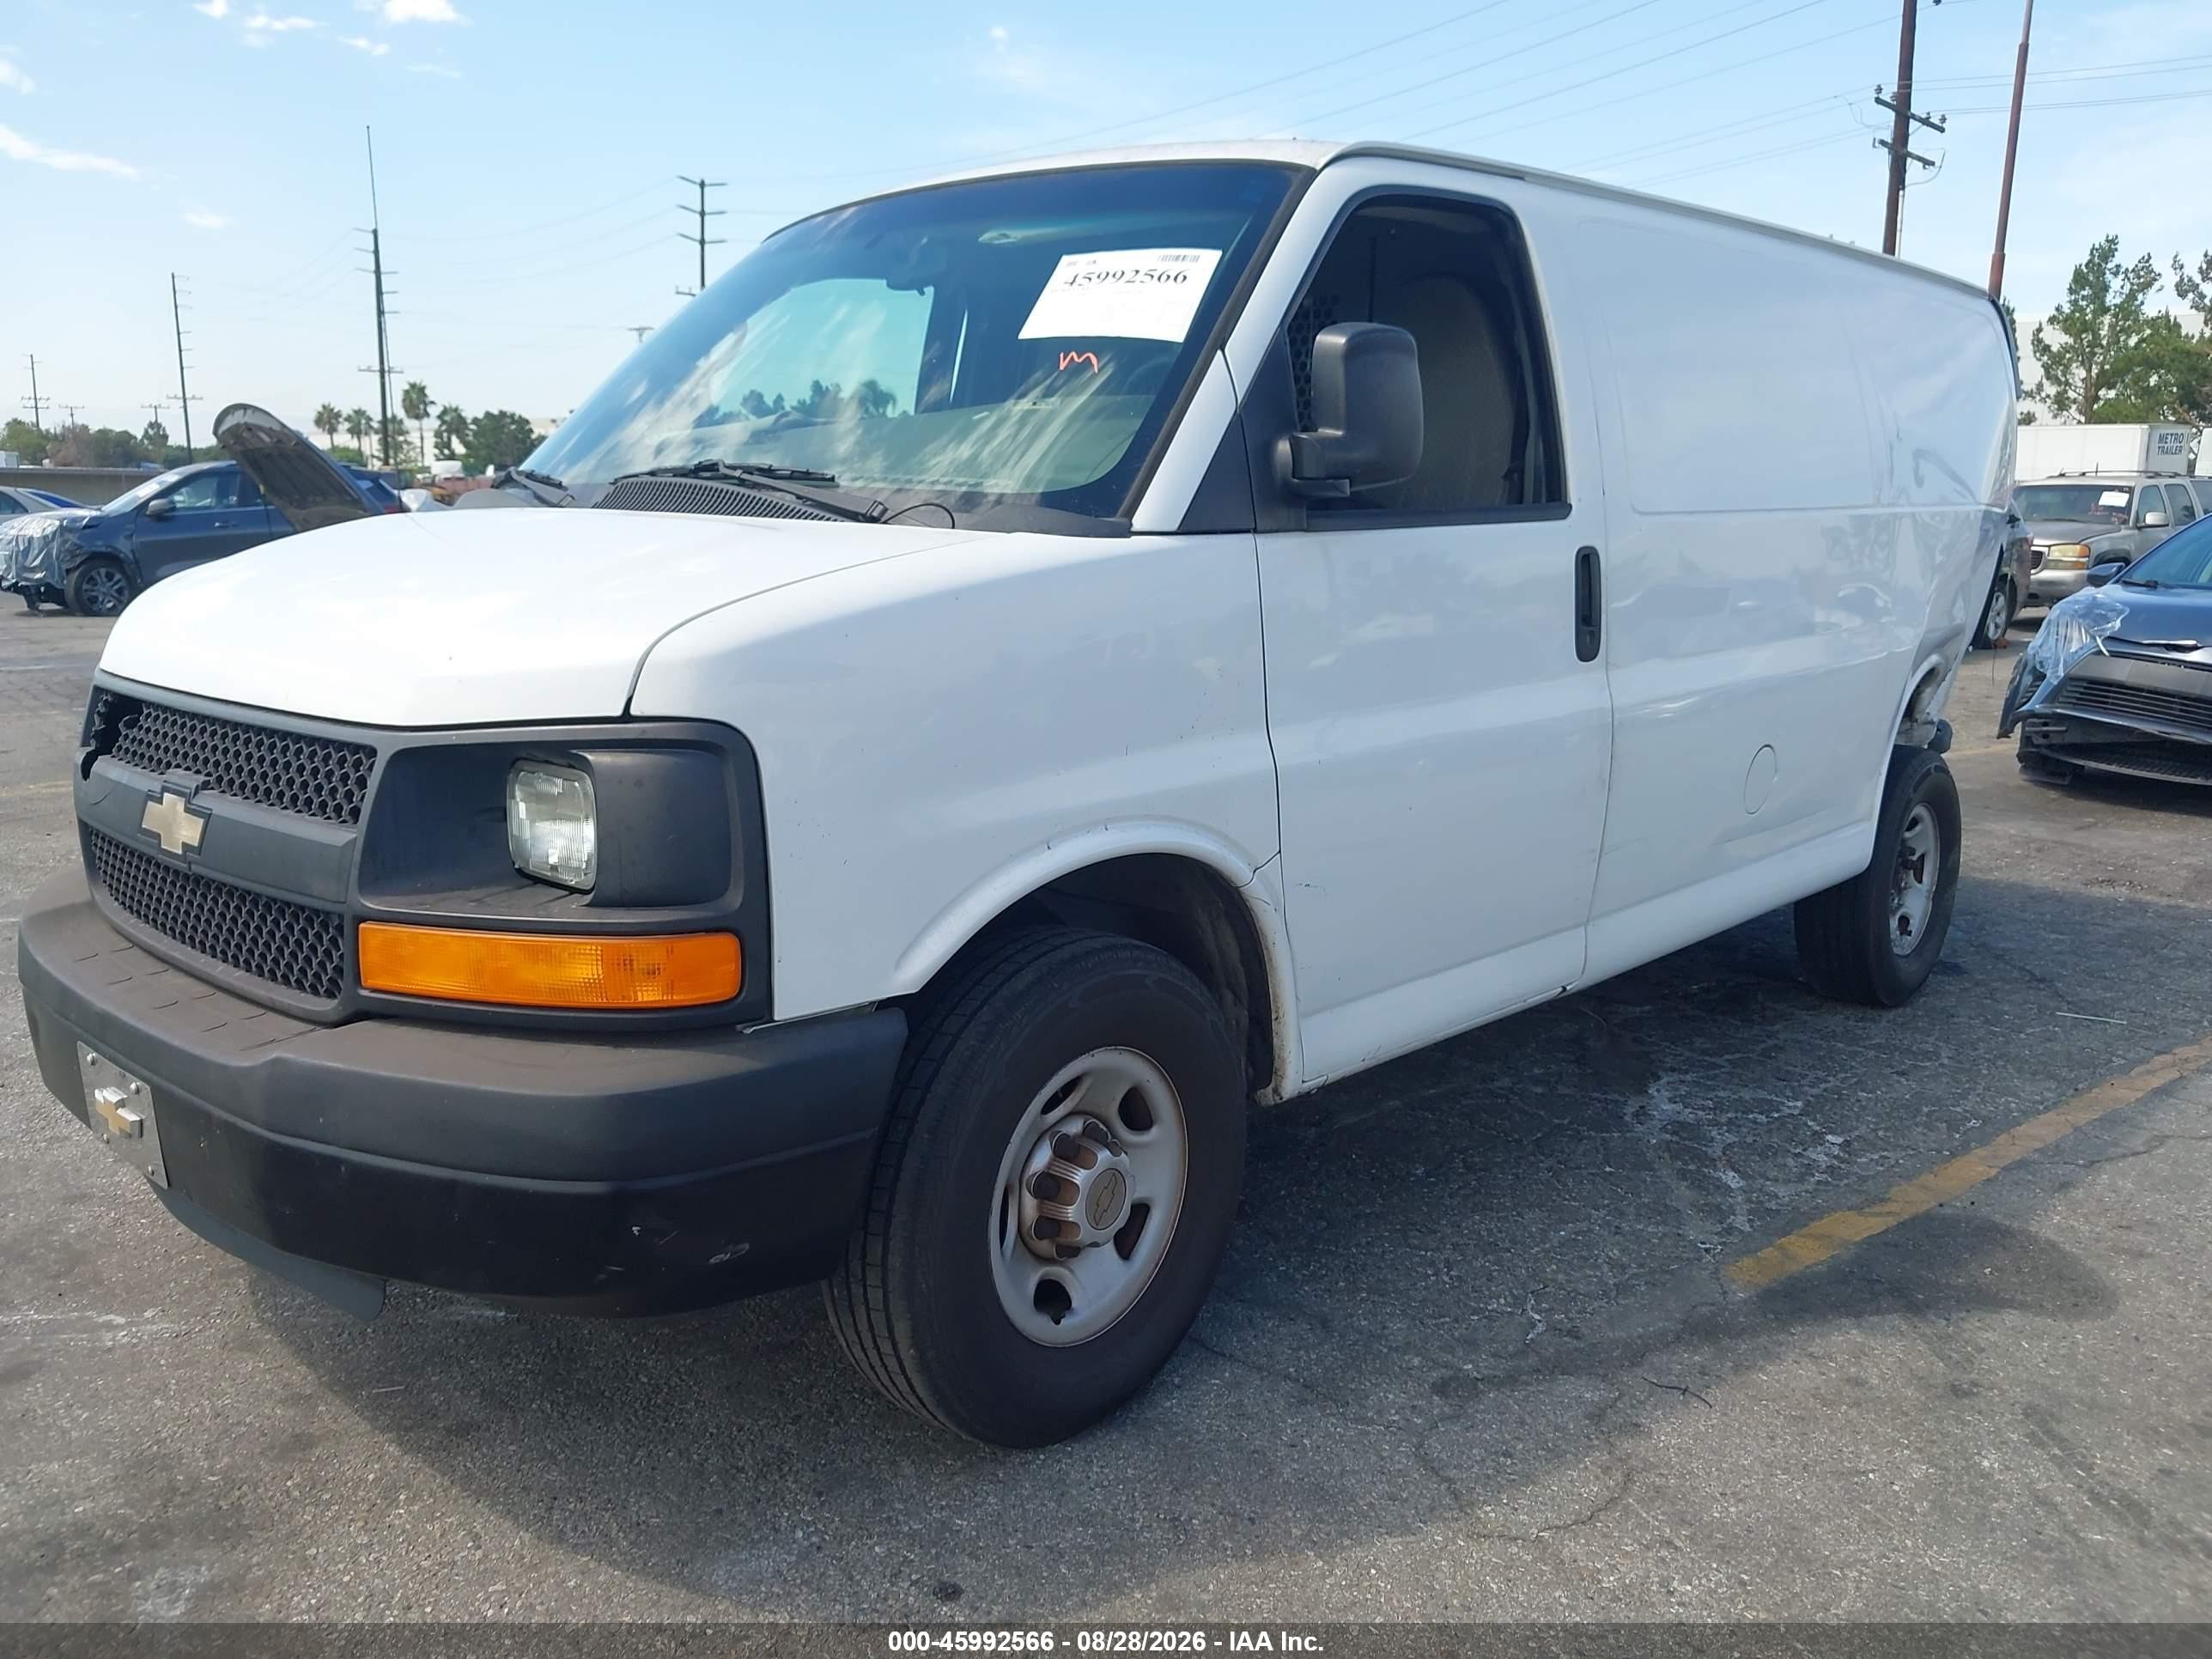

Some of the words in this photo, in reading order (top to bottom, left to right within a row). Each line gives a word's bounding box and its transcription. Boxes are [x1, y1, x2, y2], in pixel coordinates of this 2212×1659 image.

[1063, 268, 1191, 287] 45992566
[2157, 432, 2185, 445] METRO
[2157, 445, 2184, 456] TRAILER
